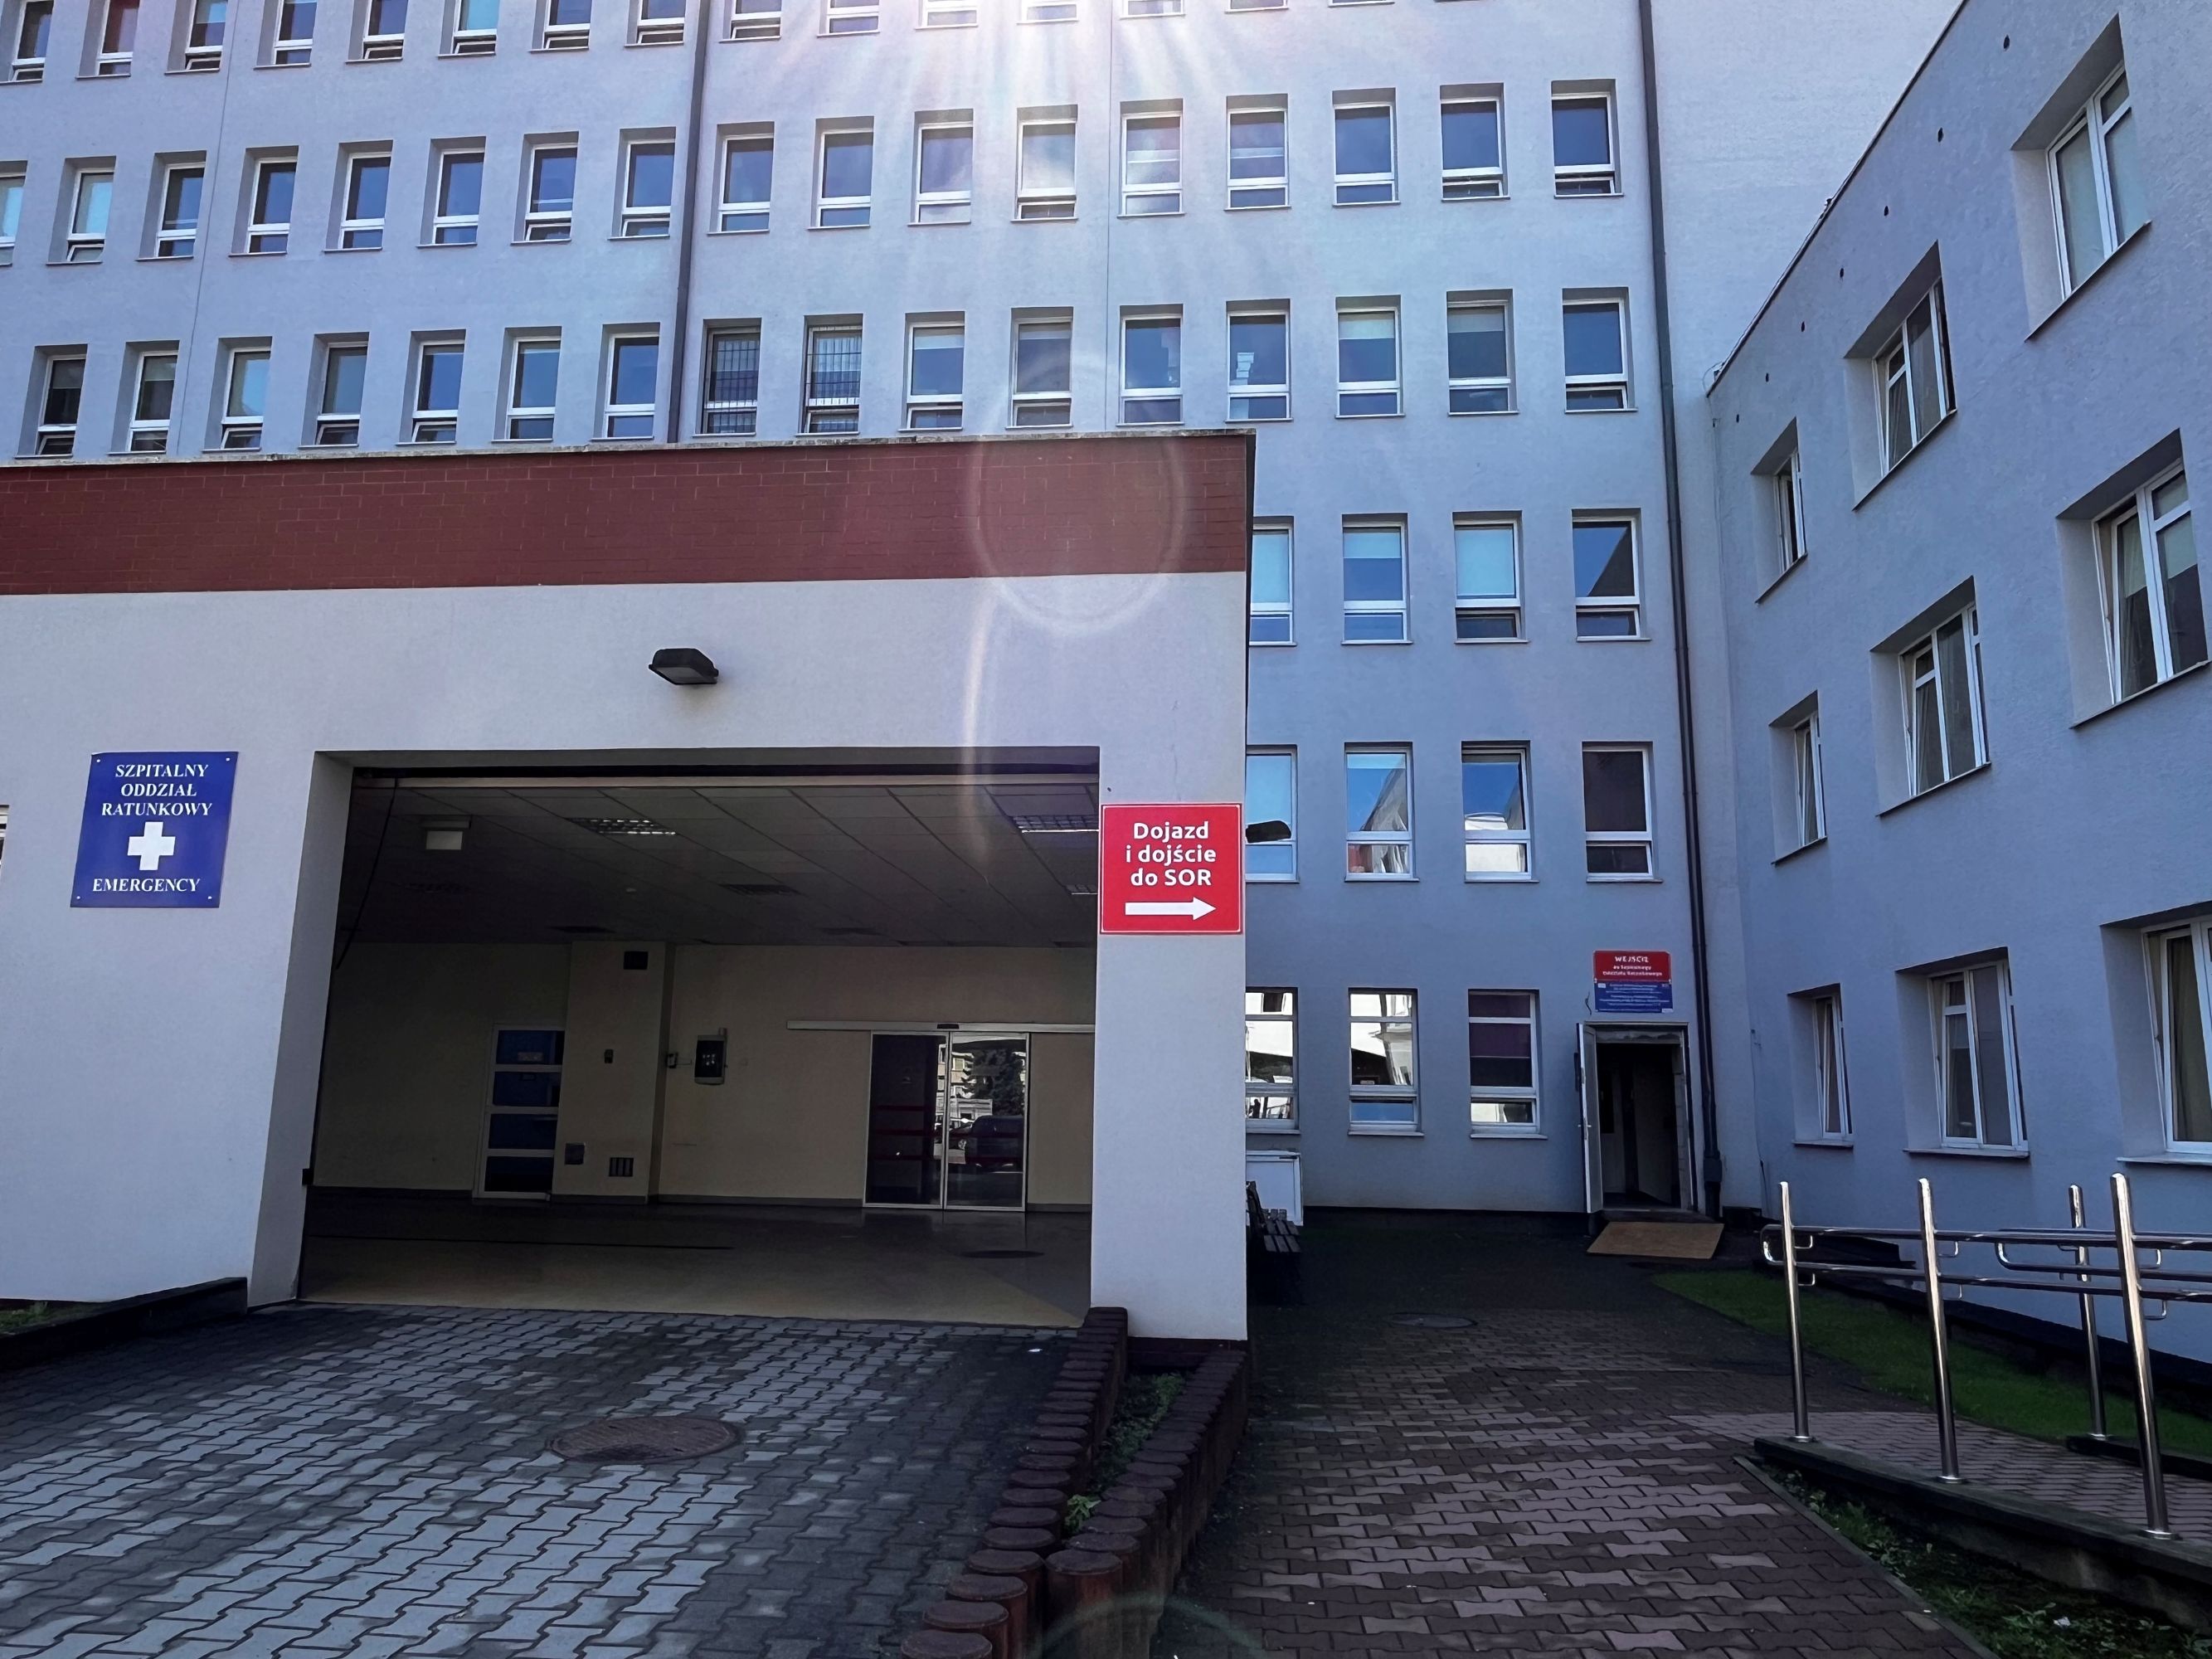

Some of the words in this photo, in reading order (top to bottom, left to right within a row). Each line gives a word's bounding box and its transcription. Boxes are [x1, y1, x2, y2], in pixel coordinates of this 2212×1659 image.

[115, 764, 208, 778] SZPITALNY
[101, 802, 213, 816] RATUNKOWY
[1133, 820, 1209, 843] Dojazd
[1125, 844, 1131, 863] i
[1137, 844, 1217, 866] dojście
[92, 878, 201, 892] EMERGENCY
[1130, 868, 1158, 886] do
[1164, 868, 1212, 886] SOR
